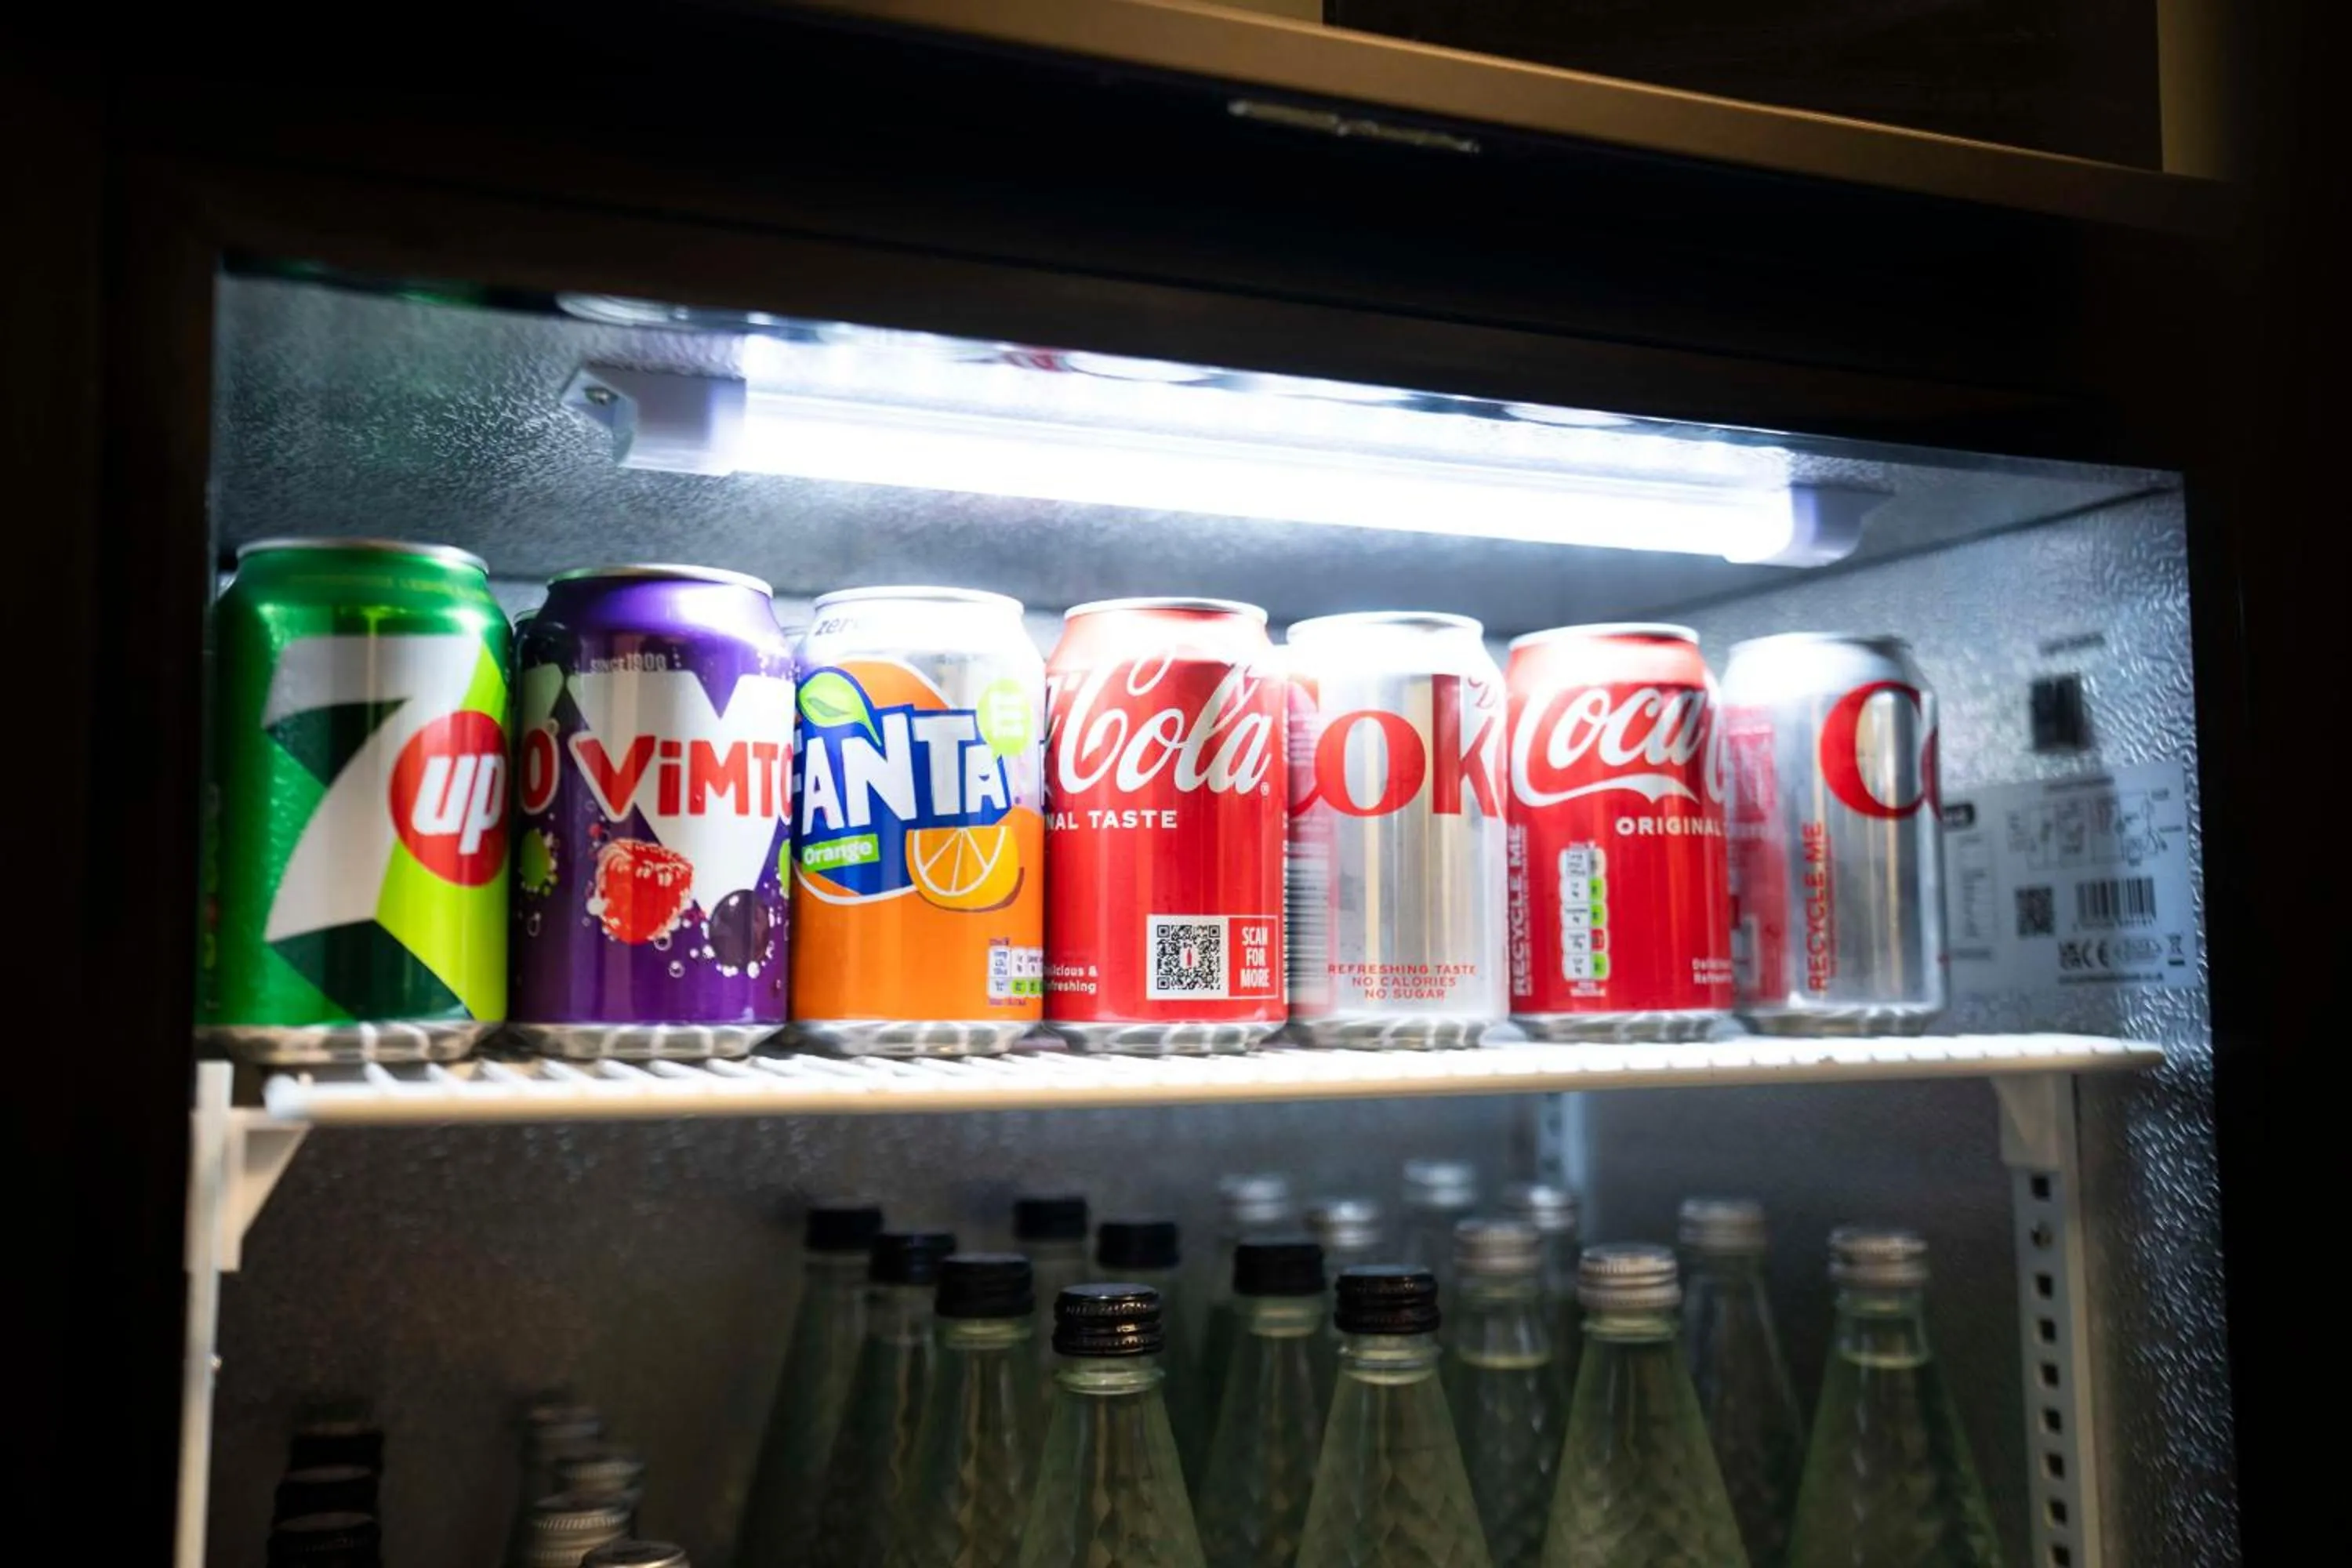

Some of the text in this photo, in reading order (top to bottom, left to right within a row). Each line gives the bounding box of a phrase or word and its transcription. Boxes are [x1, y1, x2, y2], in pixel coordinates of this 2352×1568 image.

[411, 754, 506, 855] up
[1087, 809, 1178, 829] TASTE
[1615, 815, 1722, 837] ORIGINAL
[803, 839, 873, 866] Orange
[1507, 823, 1526, 996] RECYCLE ME
[1802, 822, 1828, 993] RECYCLE ME
[1241, 926, 1269, 946] SCAN
[1246, 947, 1266, 967] FOR
[1088, 965, 1098, 977] &
[1240, 968, 1270, 989] MORE
[1328, 964, 1477, 975] REFRESHING TASTE
[1352, 976, 1457, 987] NO CALORIES
[1364, 988, 1446, 1001] NO SUGAR
